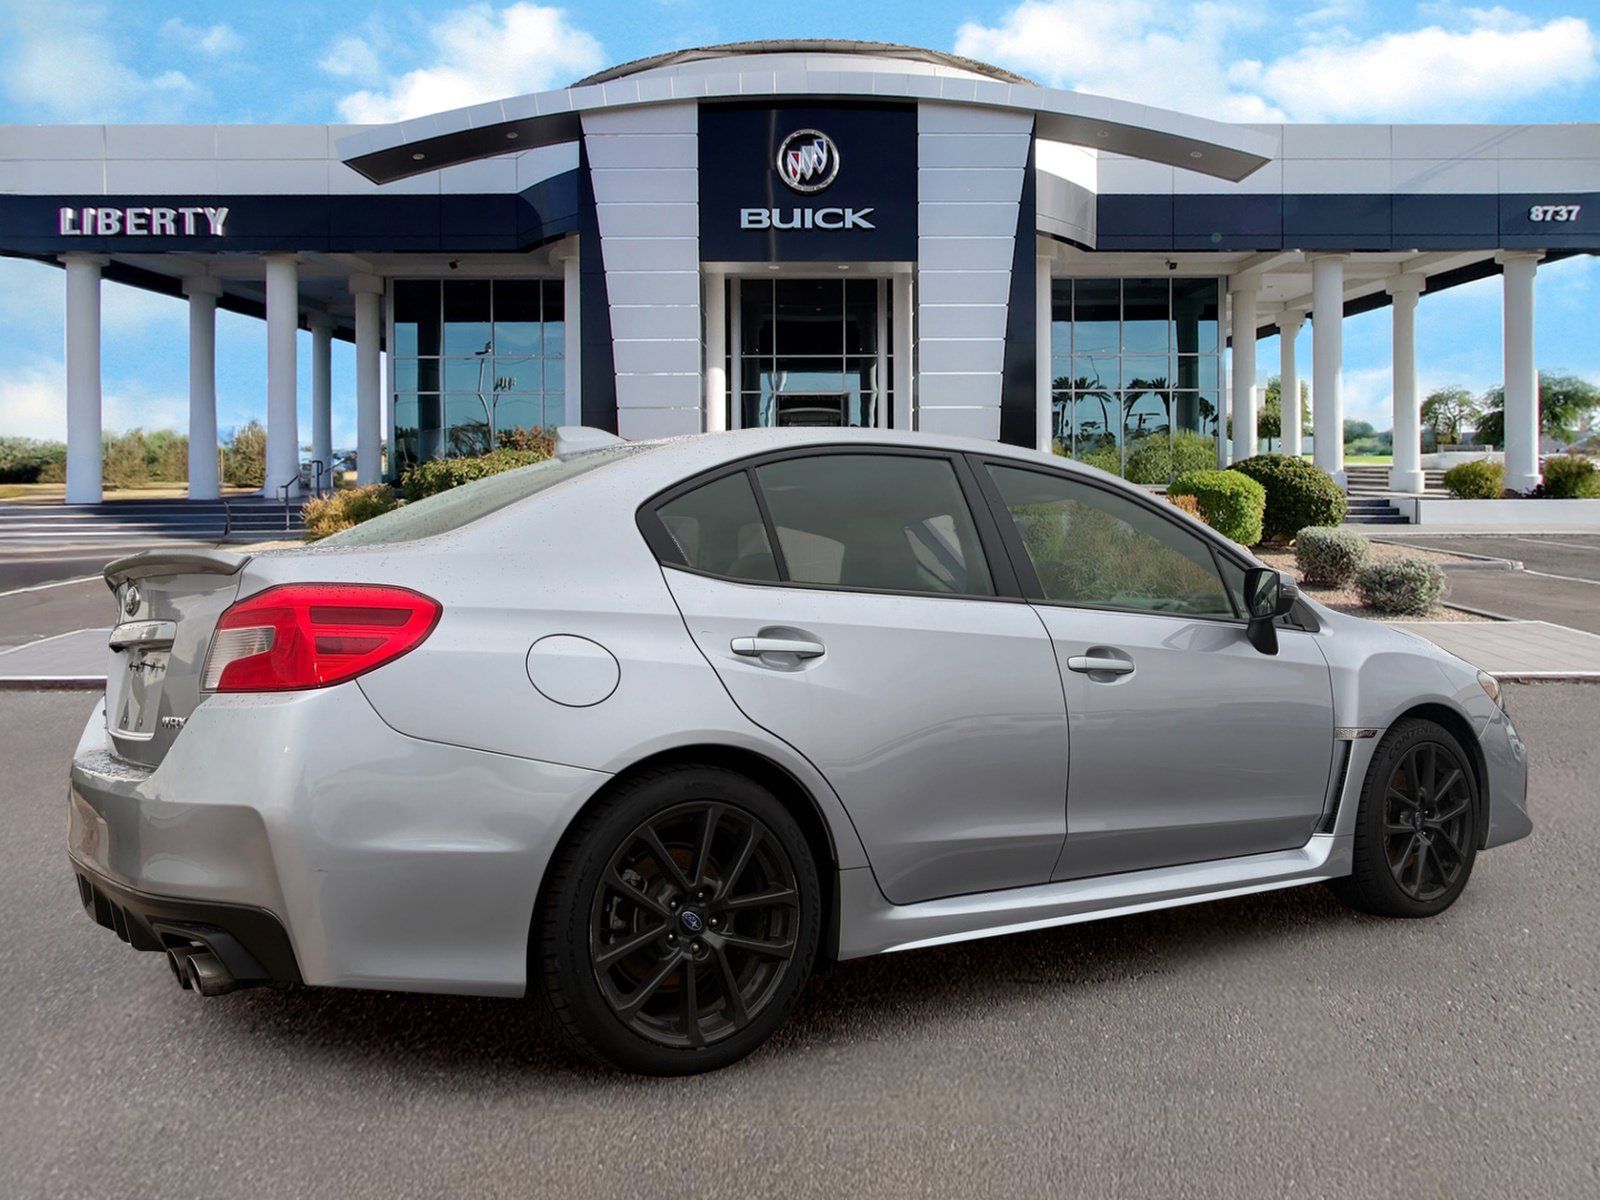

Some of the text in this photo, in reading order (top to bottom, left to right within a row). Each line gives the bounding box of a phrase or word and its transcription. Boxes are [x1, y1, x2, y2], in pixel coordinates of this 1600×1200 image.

[59, 206, 229, 236] LIBERTY
[740, 208, 876, 228] BUICK
[1529, 205, 1580, 221] 8737
